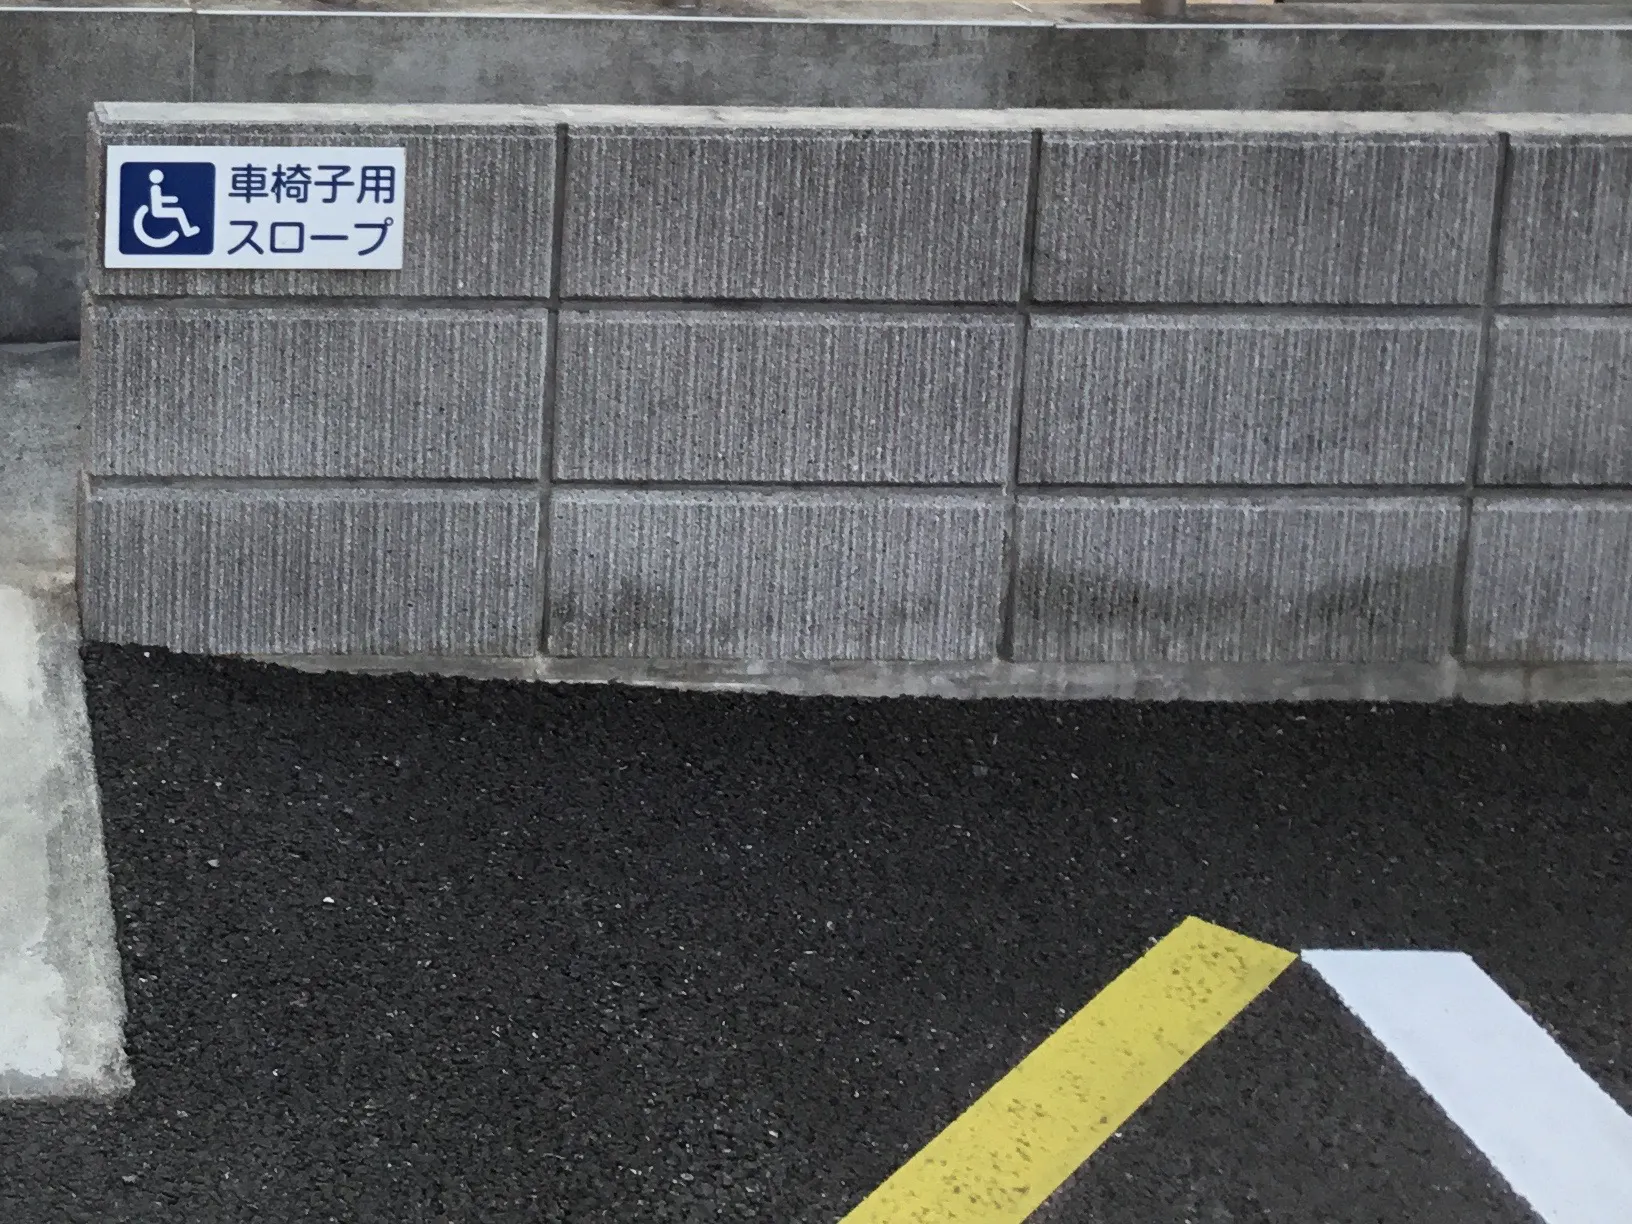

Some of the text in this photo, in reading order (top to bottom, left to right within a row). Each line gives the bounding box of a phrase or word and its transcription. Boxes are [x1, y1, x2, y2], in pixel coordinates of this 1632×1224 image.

[227, 163, 397, 204] 車椅子用
[227, 216, 395, 257] スロープ
